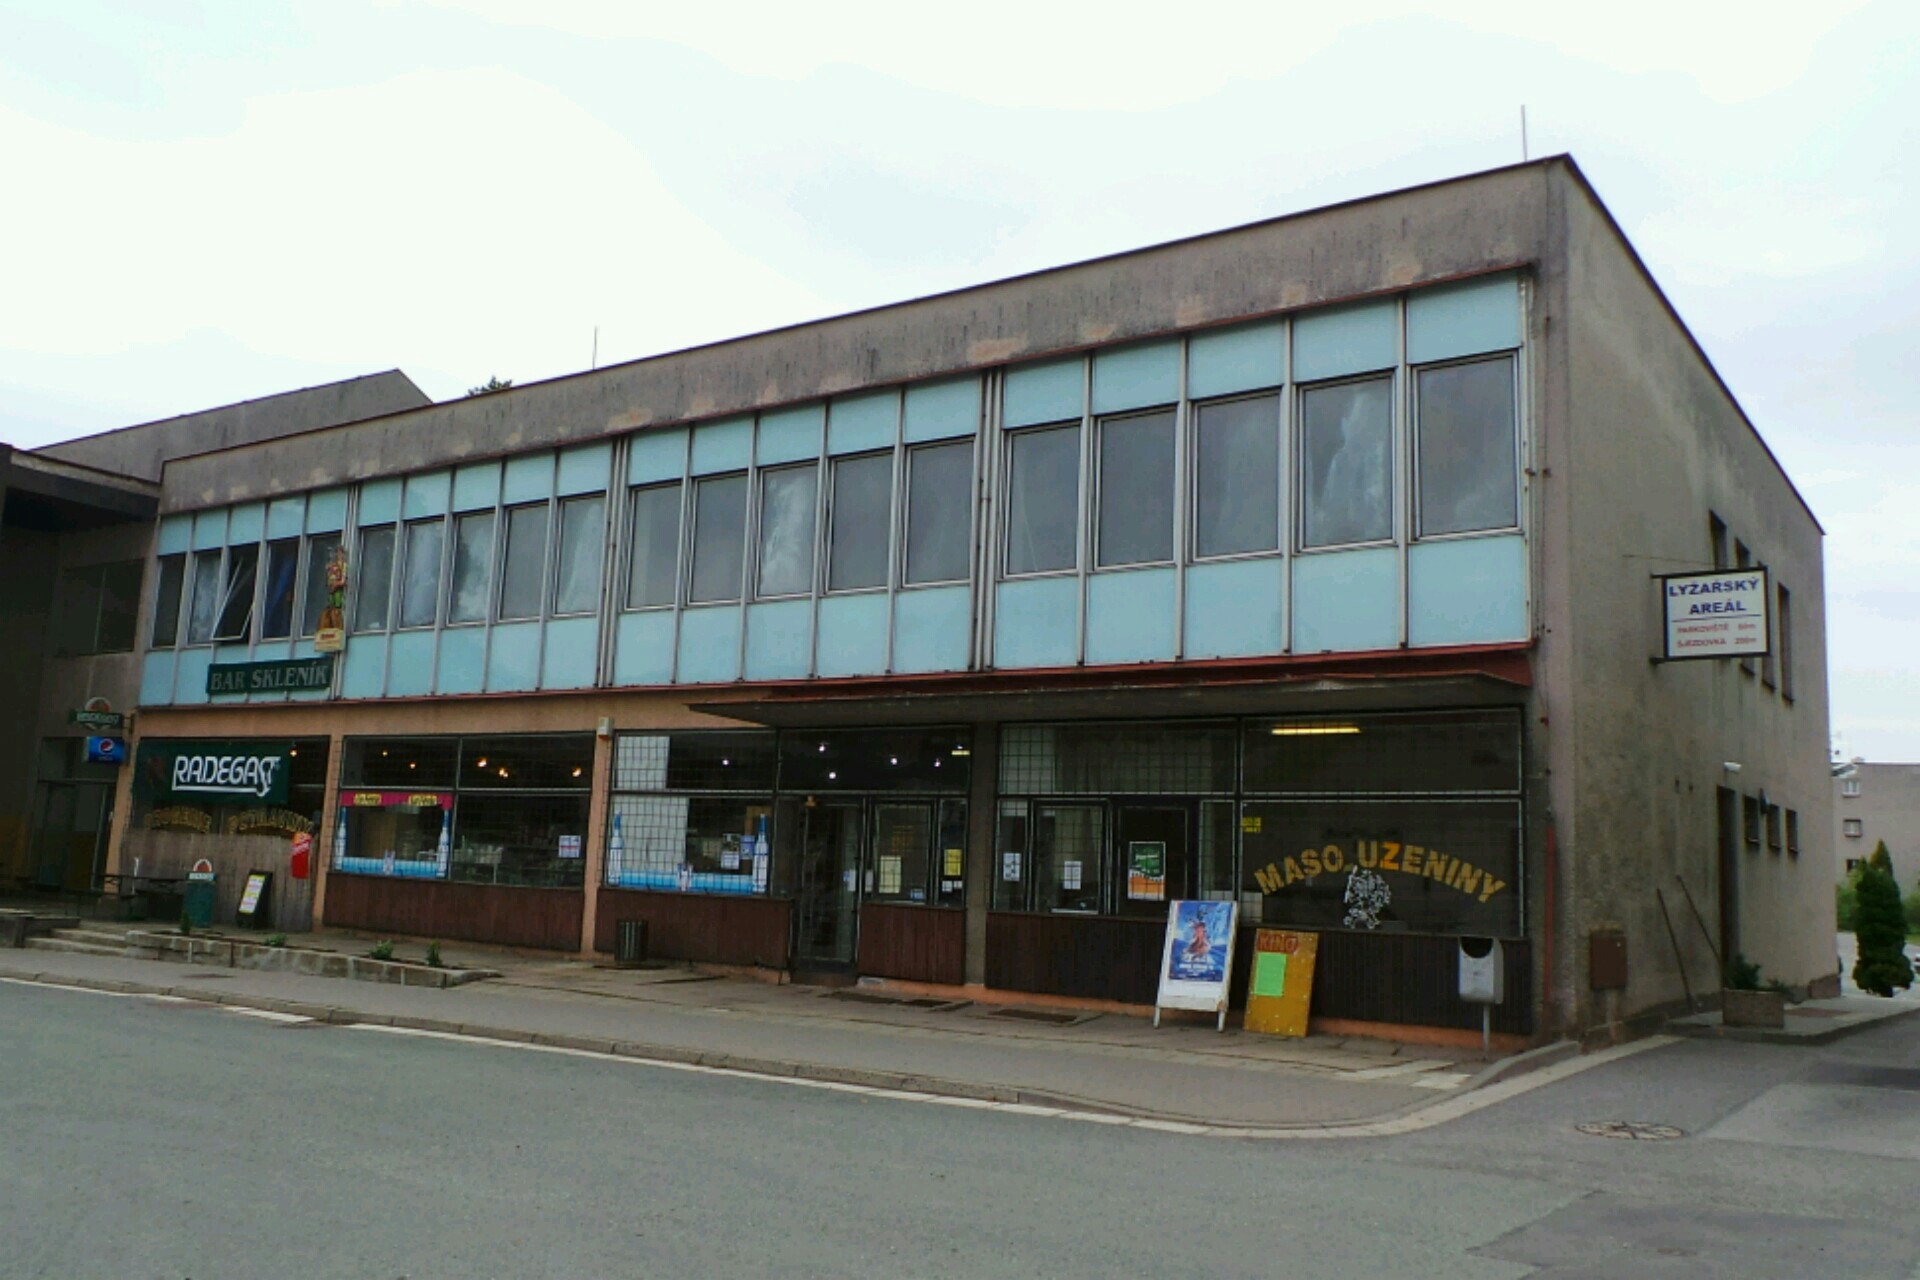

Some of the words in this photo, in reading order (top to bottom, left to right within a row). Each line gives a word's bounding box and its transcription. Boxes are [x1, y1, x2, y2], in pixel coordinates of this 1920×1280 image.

[1668, 577, 1759, 597] LYŽAŘSKÝ
[1689, 598, 1747, 615] AREÁL
[210, 671, 246, 690] BAR
[250, 661, 329, 689] SKLENÍK
[171, 755, 281, 797] RADEGAST
[1357, 840, 1506, 902] UZENINY
